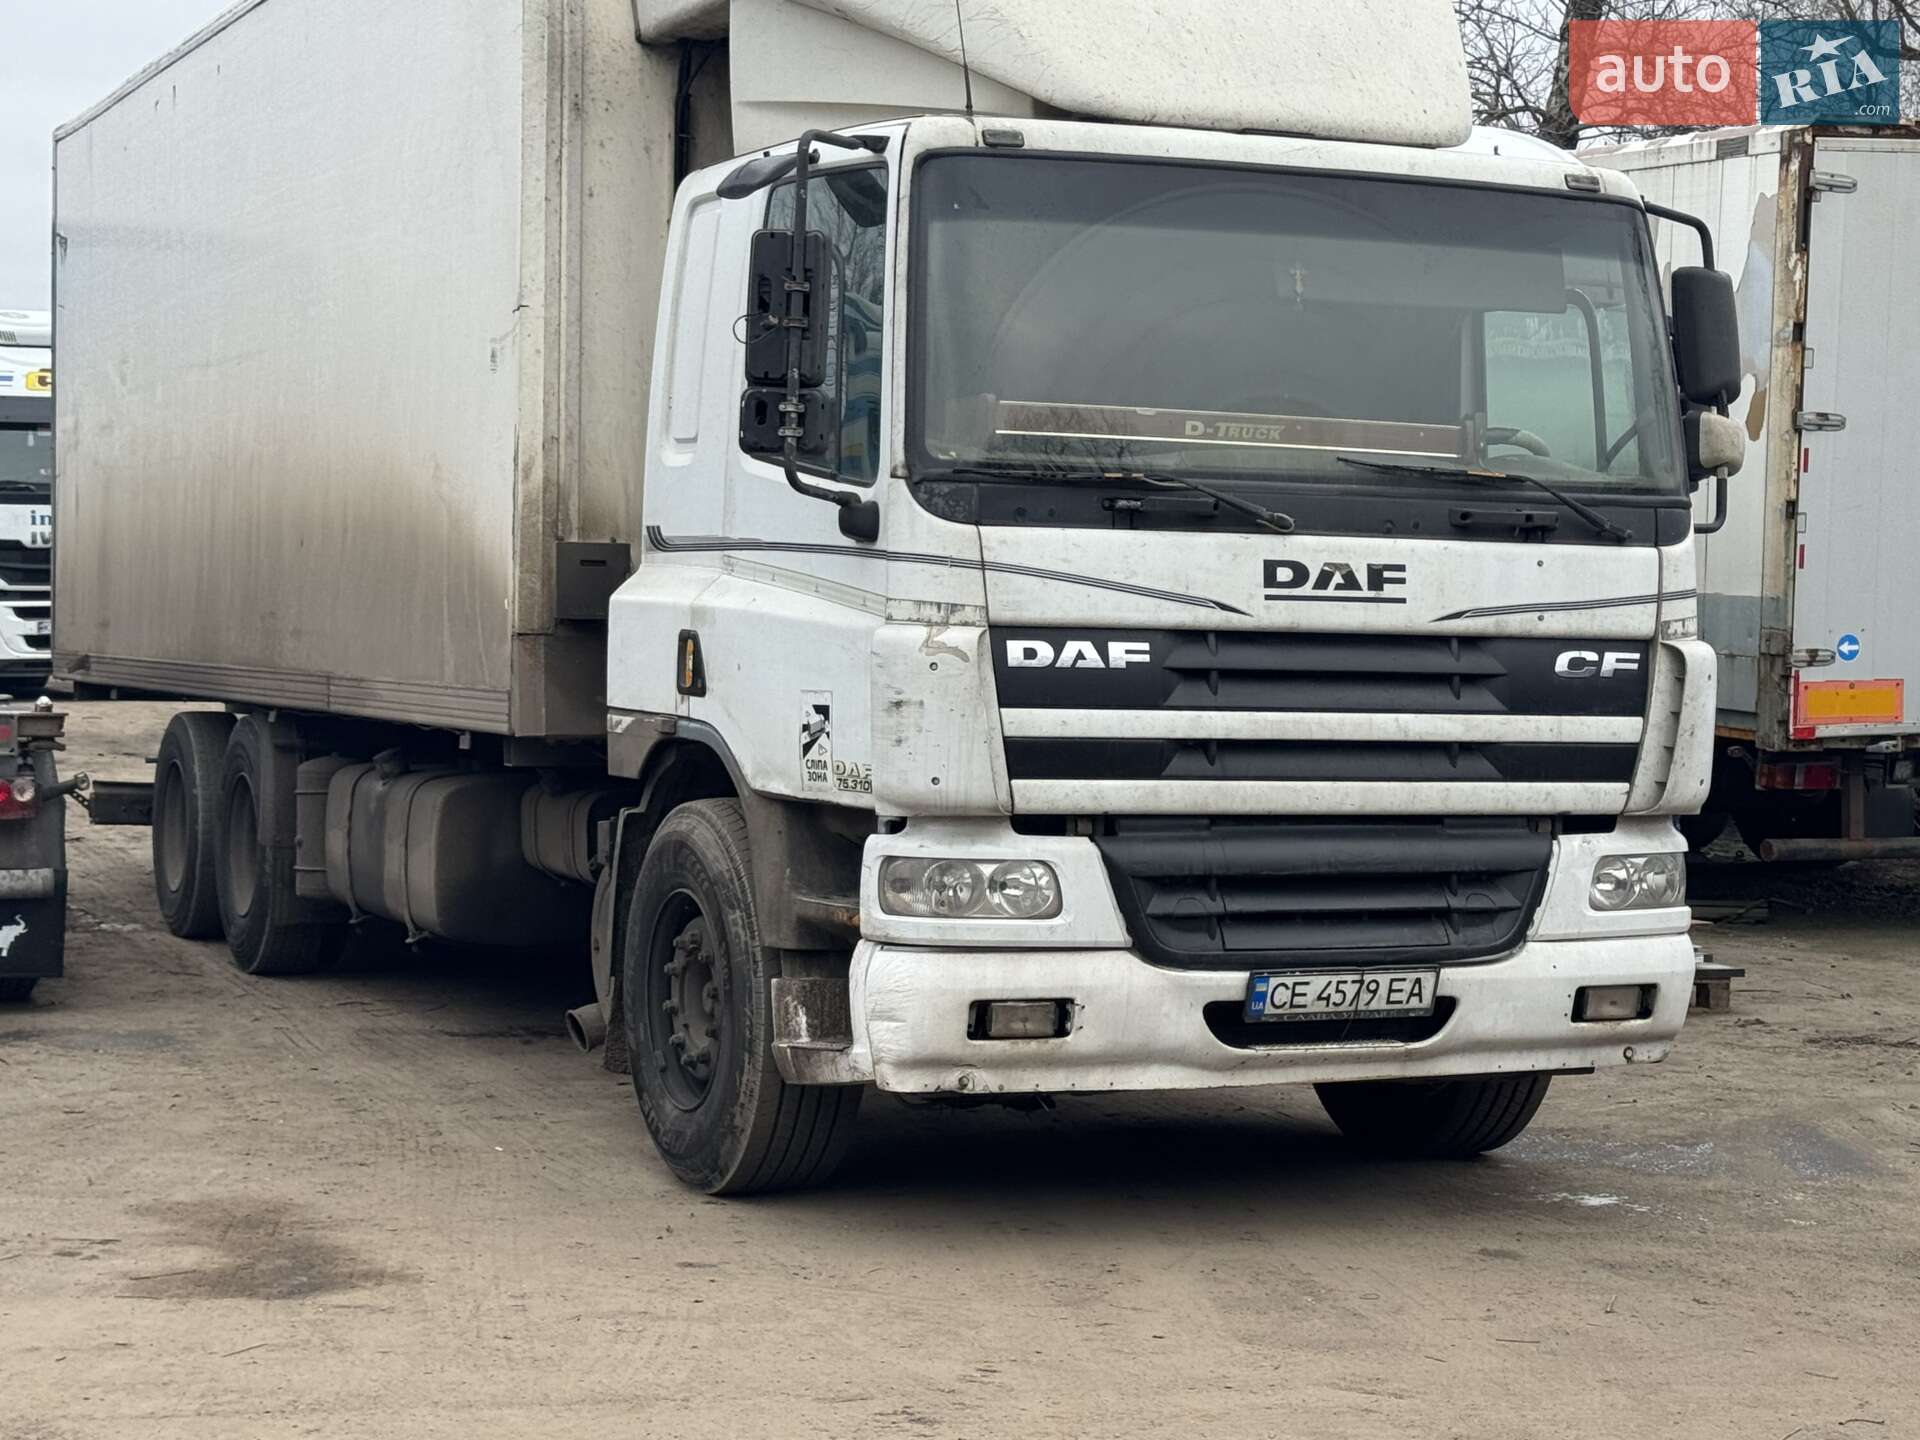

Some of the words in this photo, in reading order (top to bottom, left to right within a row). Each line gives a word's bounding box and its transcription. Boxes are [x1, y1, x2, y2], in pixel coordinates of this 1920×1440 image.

[1263, 559, 1407, 592] DAF
[1005, 639, 1151, 669] DAF
[1554, 649, 1641, 678] CF
[805, 759, 828, 771] СЛІПА
[807, 771, 828, 783] ЗОНА
[1251, 1002, 1264, 1011] UA
[1270, 981, 1310, 1010] CE
[1316, 979, 1380, 1009] 4579
[1386, 977, 1424, 1005] EA
